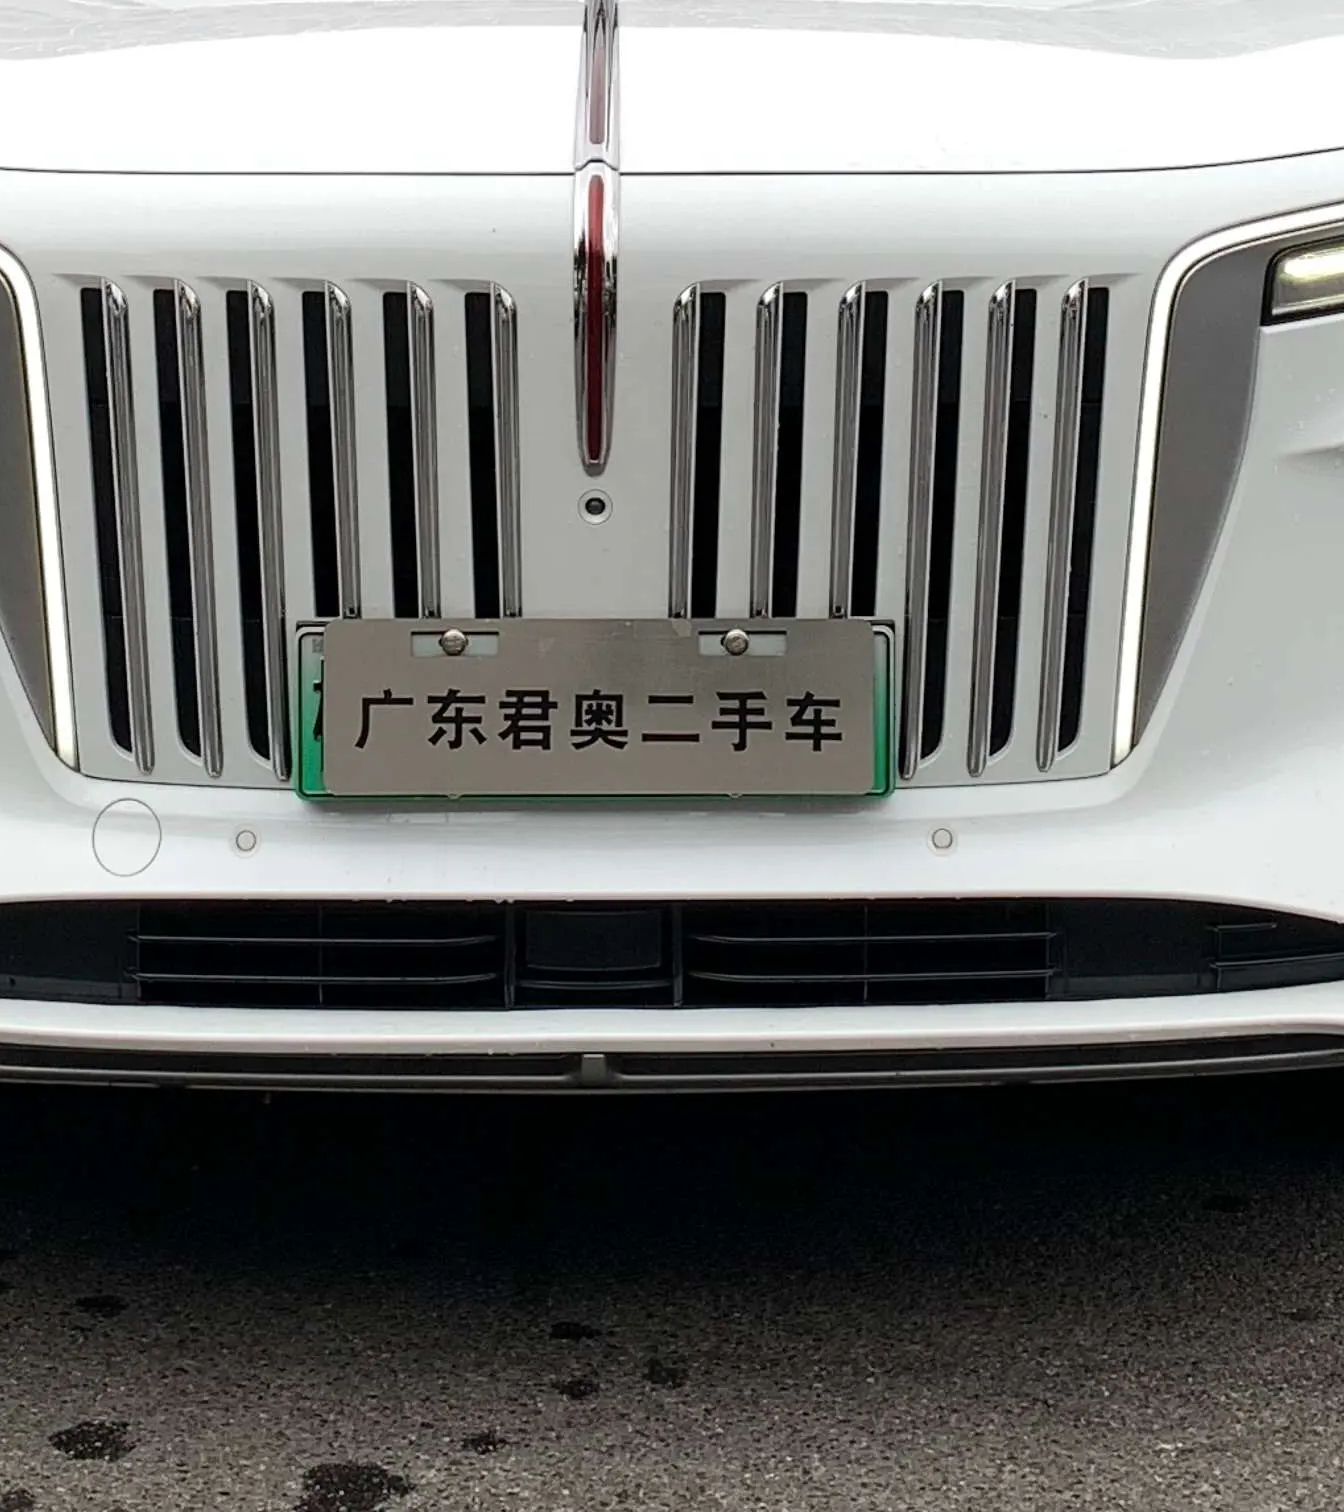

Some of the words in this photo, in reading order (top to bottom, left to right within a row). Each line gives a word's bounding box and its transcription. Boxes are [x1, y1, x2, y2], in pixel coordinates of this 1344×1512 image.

[354, 687, 844, 752] 广东君奥二手车
